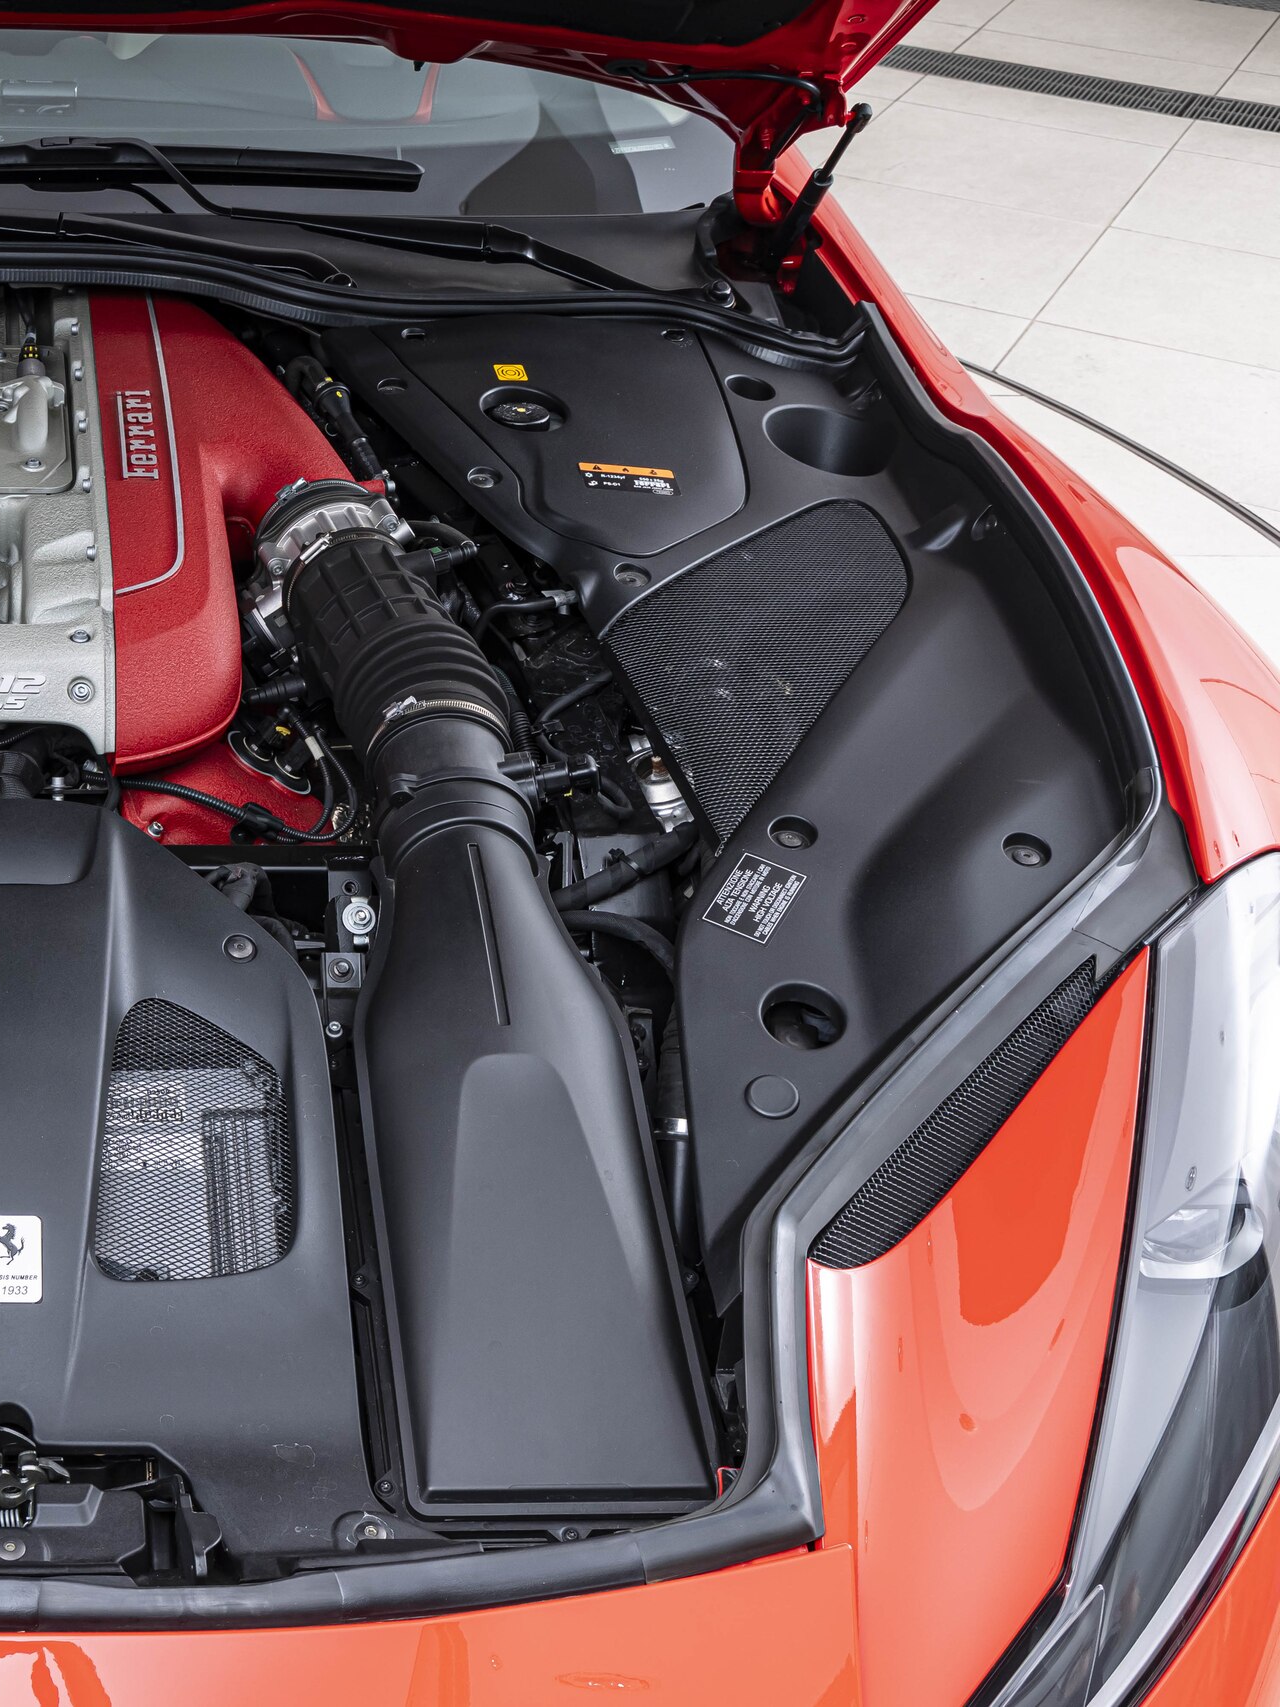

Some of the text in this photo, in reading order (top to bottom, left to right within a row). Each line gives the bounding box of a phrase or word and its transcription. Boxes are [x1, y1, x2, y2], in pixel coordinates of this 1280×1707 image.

[116, 389, 159, 480] Ferrari
[716, 869, 744, 905] ATTENZIONE
[722, 869, 754, 912] ALTA TENSIONE
[748, 885, 771, 913] WARNING
[753, 882, 783, 923] HIGH VOLTAGE
